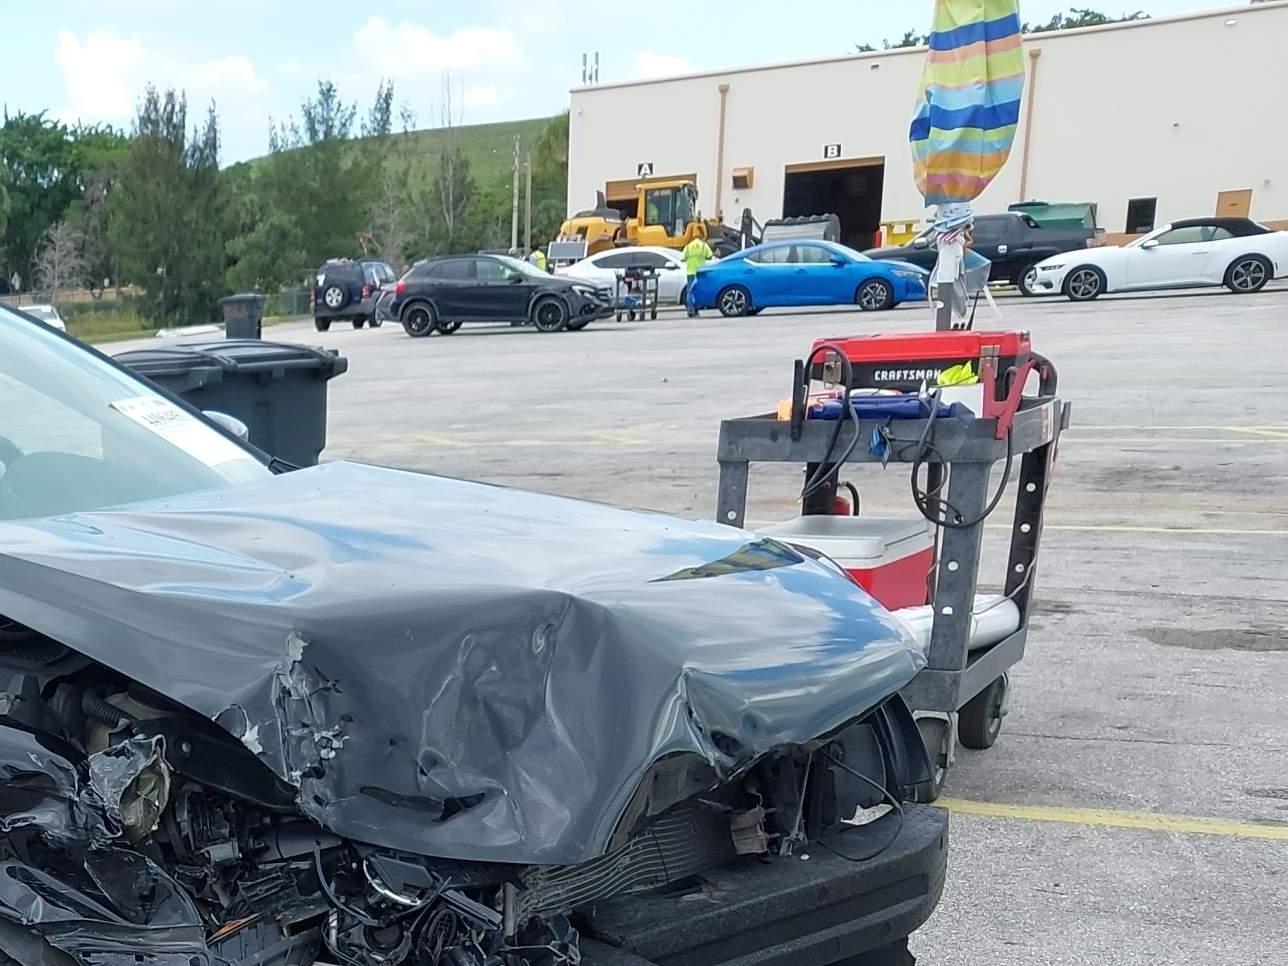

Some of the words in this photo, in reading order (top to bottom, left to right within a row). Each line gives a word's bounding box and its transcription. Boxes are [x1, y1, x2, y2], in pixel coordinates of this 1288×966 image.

[827, 145, 839, 157] B
[639, 163, 651, 176] A
[874, 368, 942, 381] CRAFTSMAN
